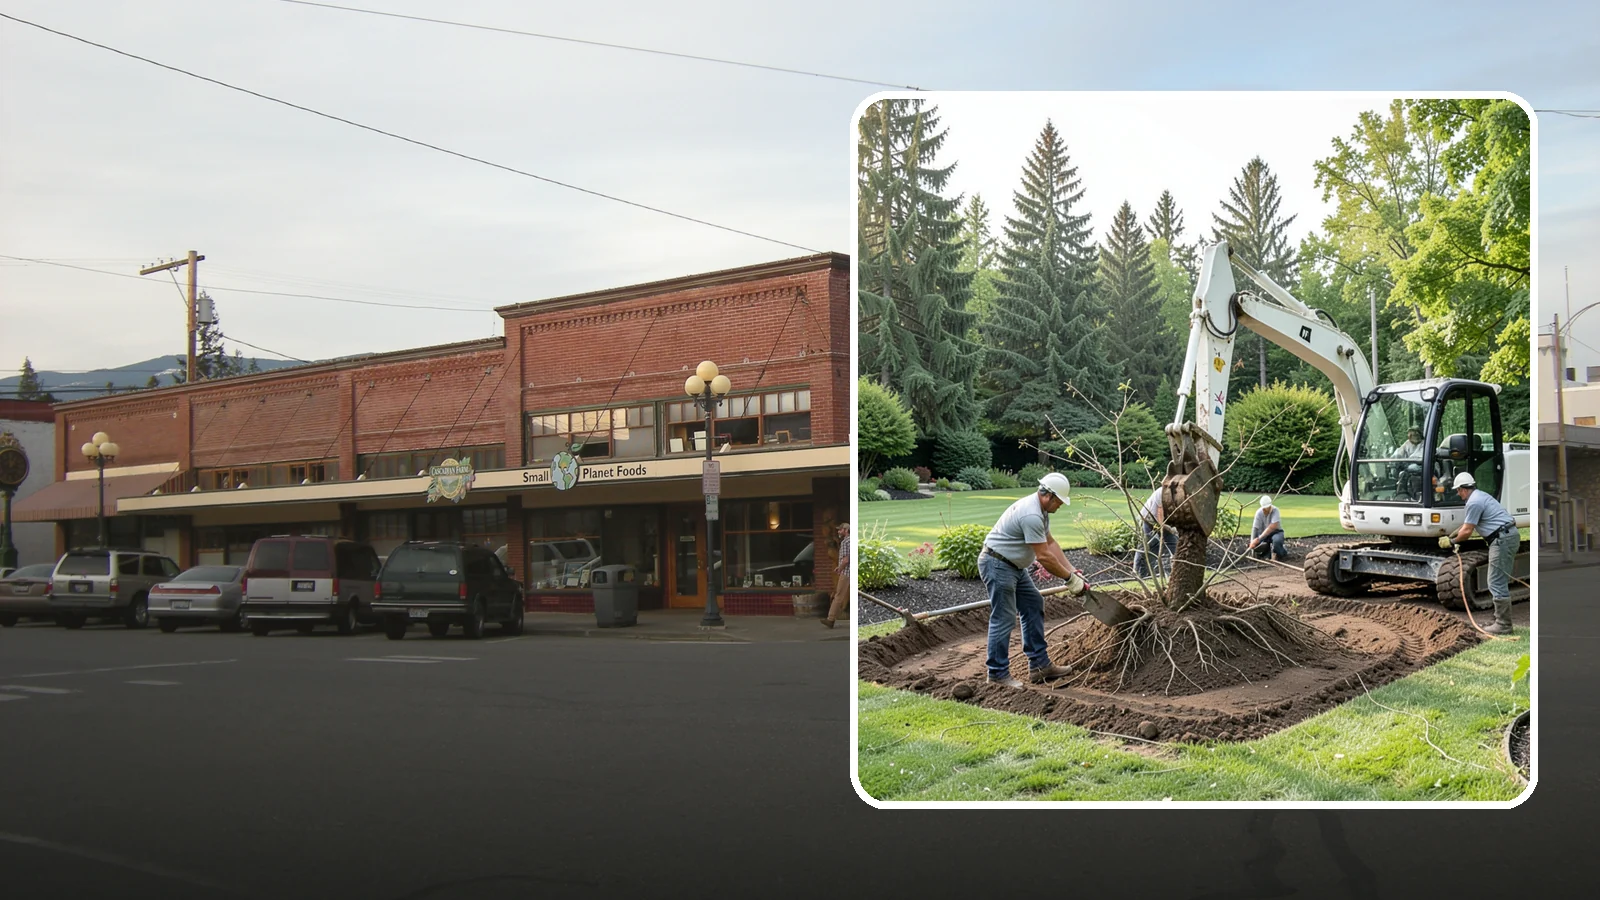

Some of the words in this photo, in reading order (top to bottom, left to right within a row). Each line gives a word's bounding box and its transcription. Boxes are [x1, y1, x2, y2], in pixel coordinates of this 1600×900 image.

[431, 466, 455, 476] CASCADIAN
[523, 471, 549, 482] Small
[583, 467, 614, 479] Planet
[617, 464, 647, 476] Foods
